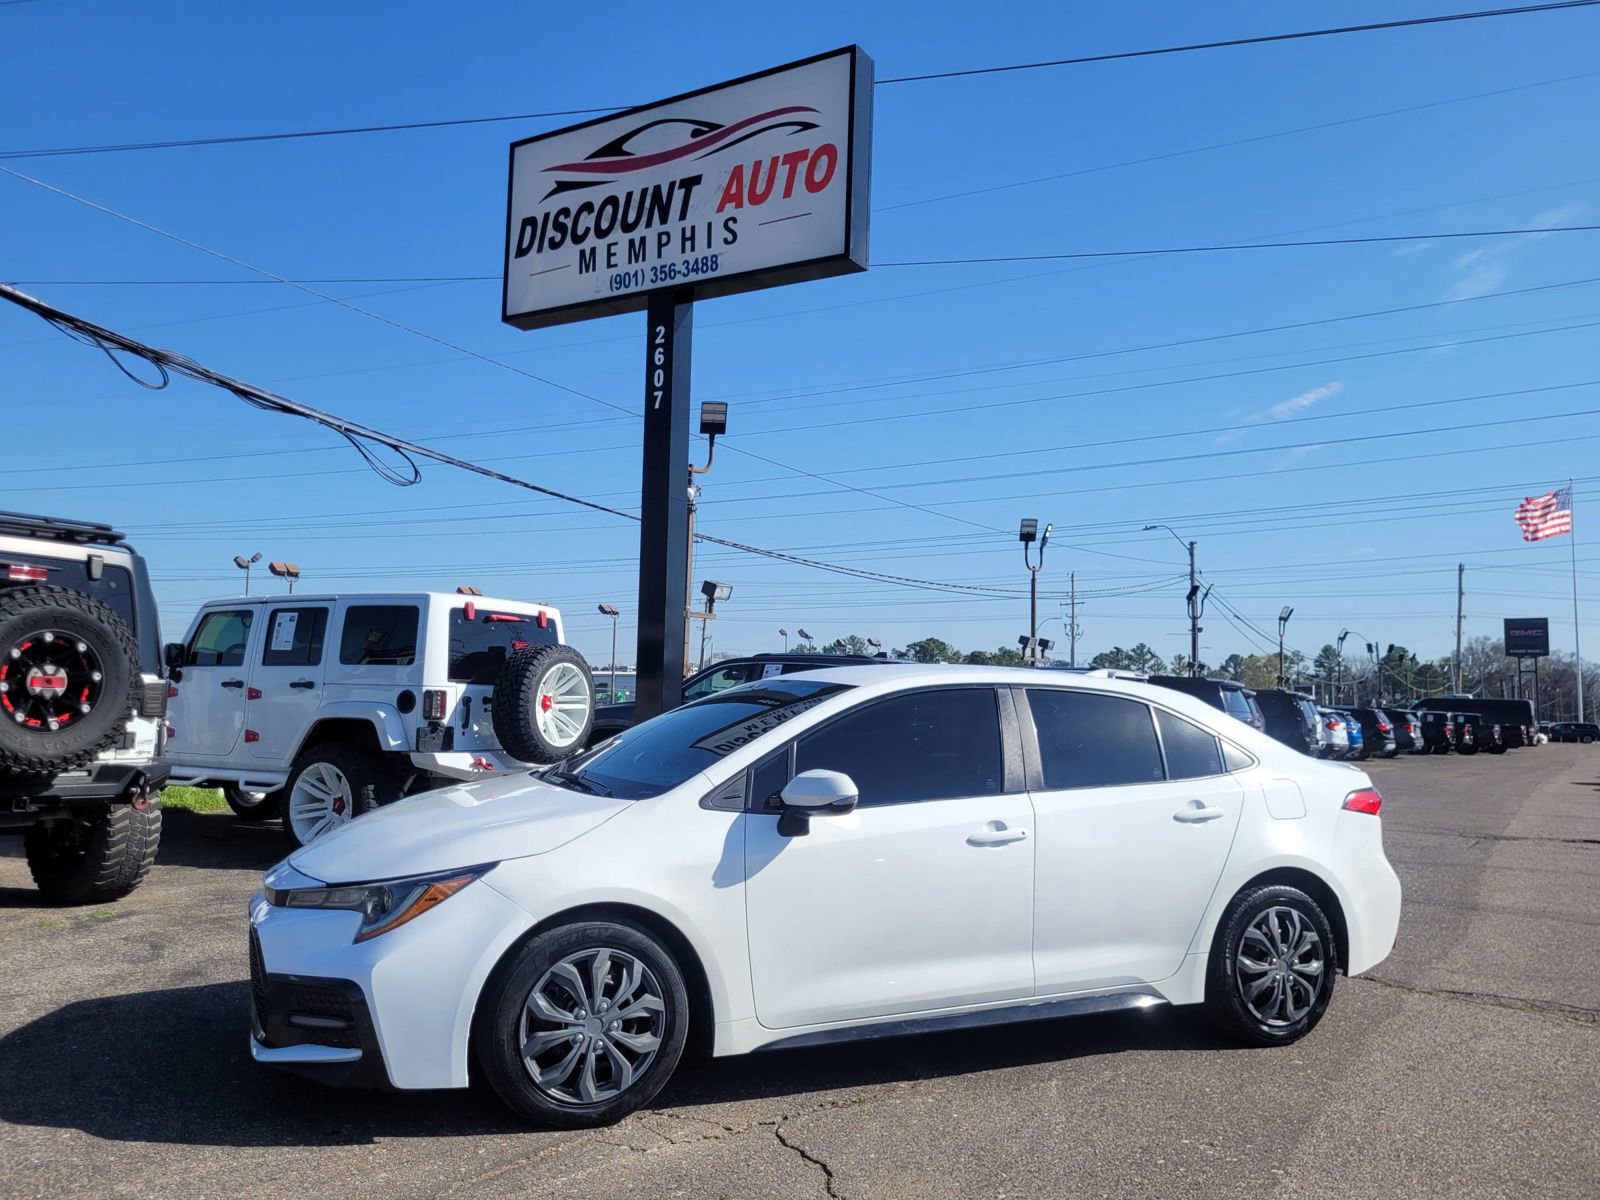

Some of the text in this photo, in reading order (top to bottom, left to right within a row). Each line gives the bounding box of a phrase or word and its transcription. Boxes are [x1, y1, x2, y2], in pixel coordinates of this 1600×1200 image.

[514, 143, 839, 259] DISCOUNT AUTO
[578, 217, 739, 275] MEMPHIS
[609, 254, 719, 291] (901) 356-3488
[653, 326, 666, 409] 2607
